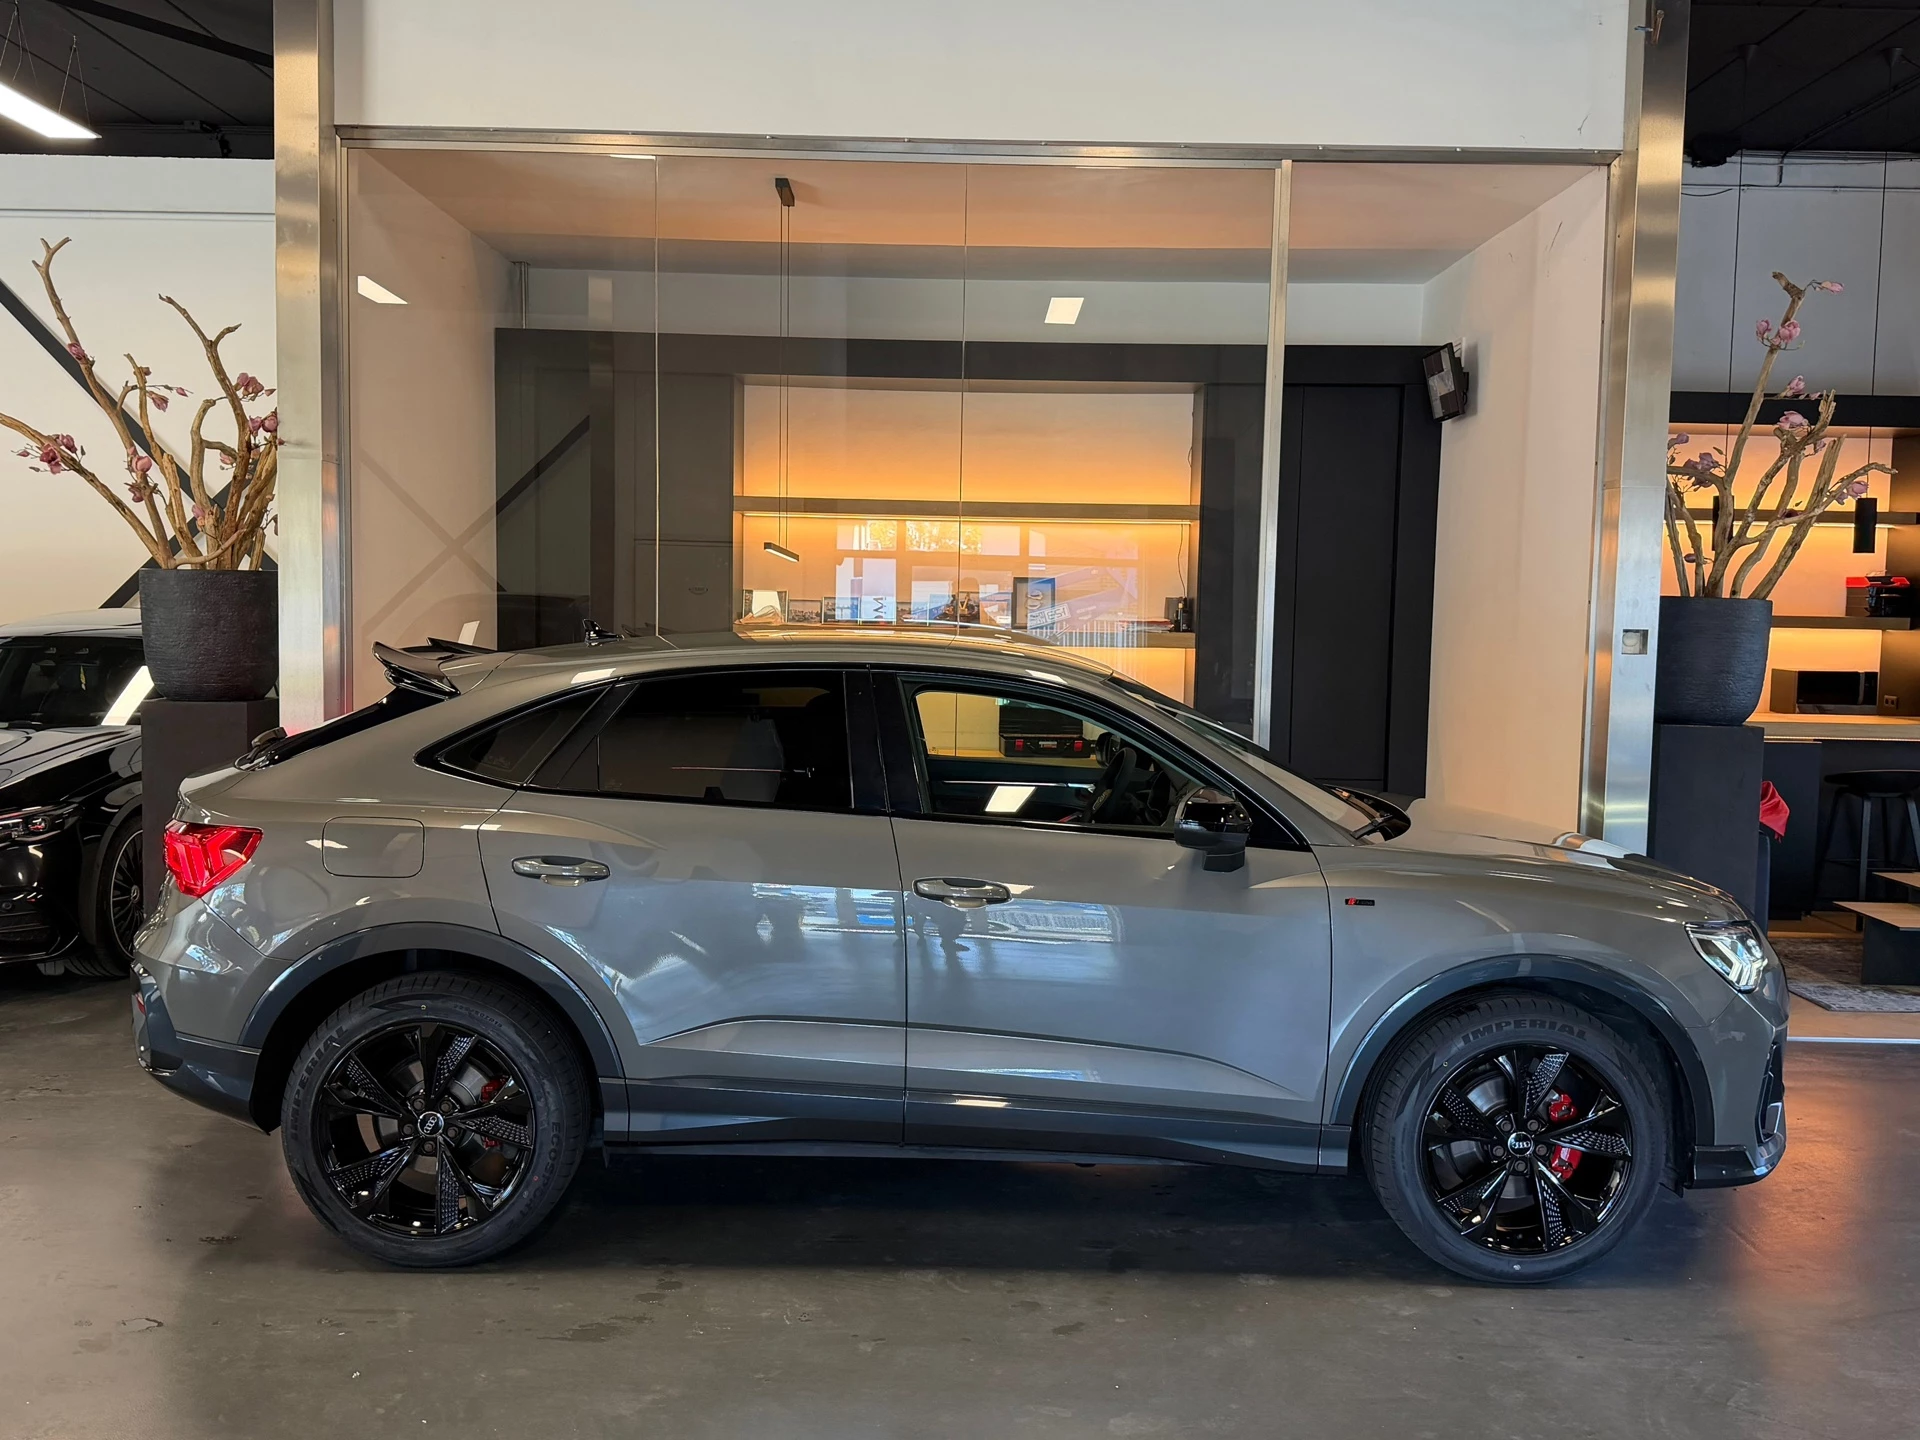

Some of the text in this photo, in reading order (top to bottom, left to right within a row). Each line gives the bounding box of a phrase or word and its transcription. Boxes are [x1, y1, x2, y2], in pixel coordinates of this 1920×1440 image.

[1462, 1018, 1587, 1046] IMPERIAL
[290, 1025, 349, 1141] IMPERIAL
[519, 1121, 561, 1217] ECOSPORT
